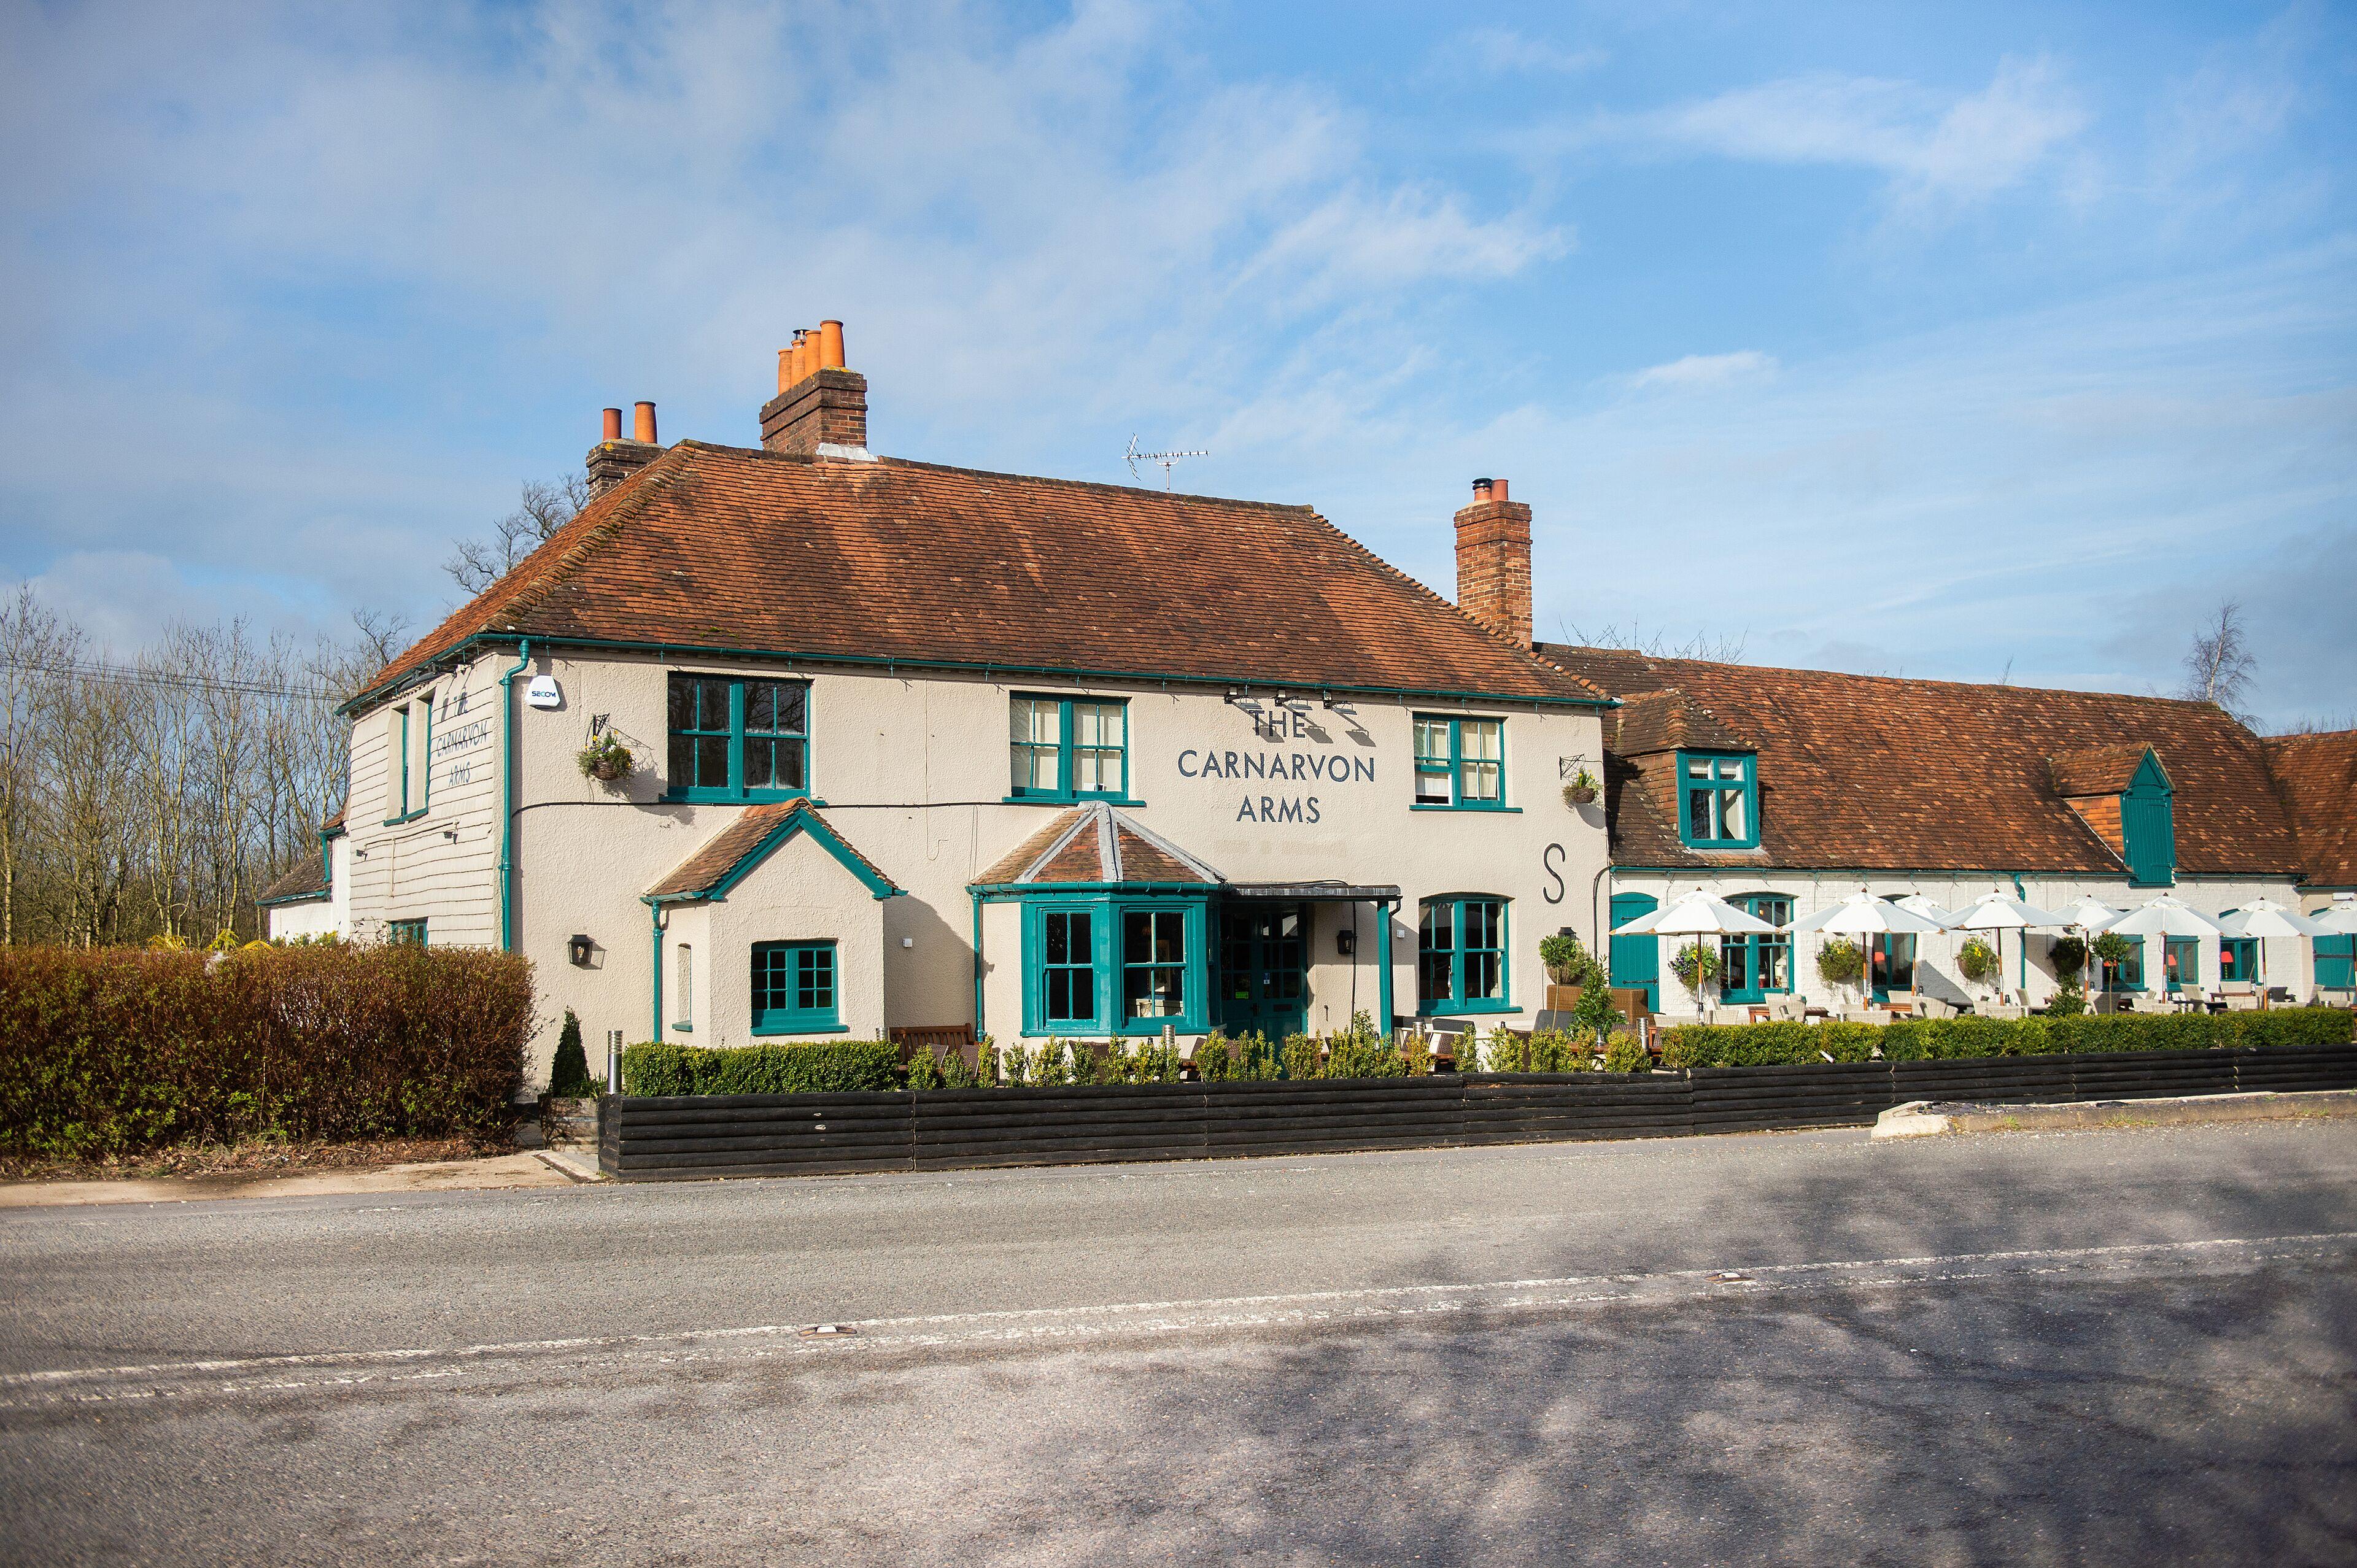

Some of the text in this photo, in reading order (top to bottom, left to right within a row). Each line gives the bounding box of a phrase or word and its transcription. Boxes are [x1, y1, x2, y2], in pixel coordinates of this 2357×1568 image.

[1248, 709, 1306, 738] THE
[436, 720, 488, 757] CARNARVON
[448, 761, 471, 787] ARMS
[1177, 749, 1374, 782] CARNARVON
[1236, 795, 1320, 824] ARMS
